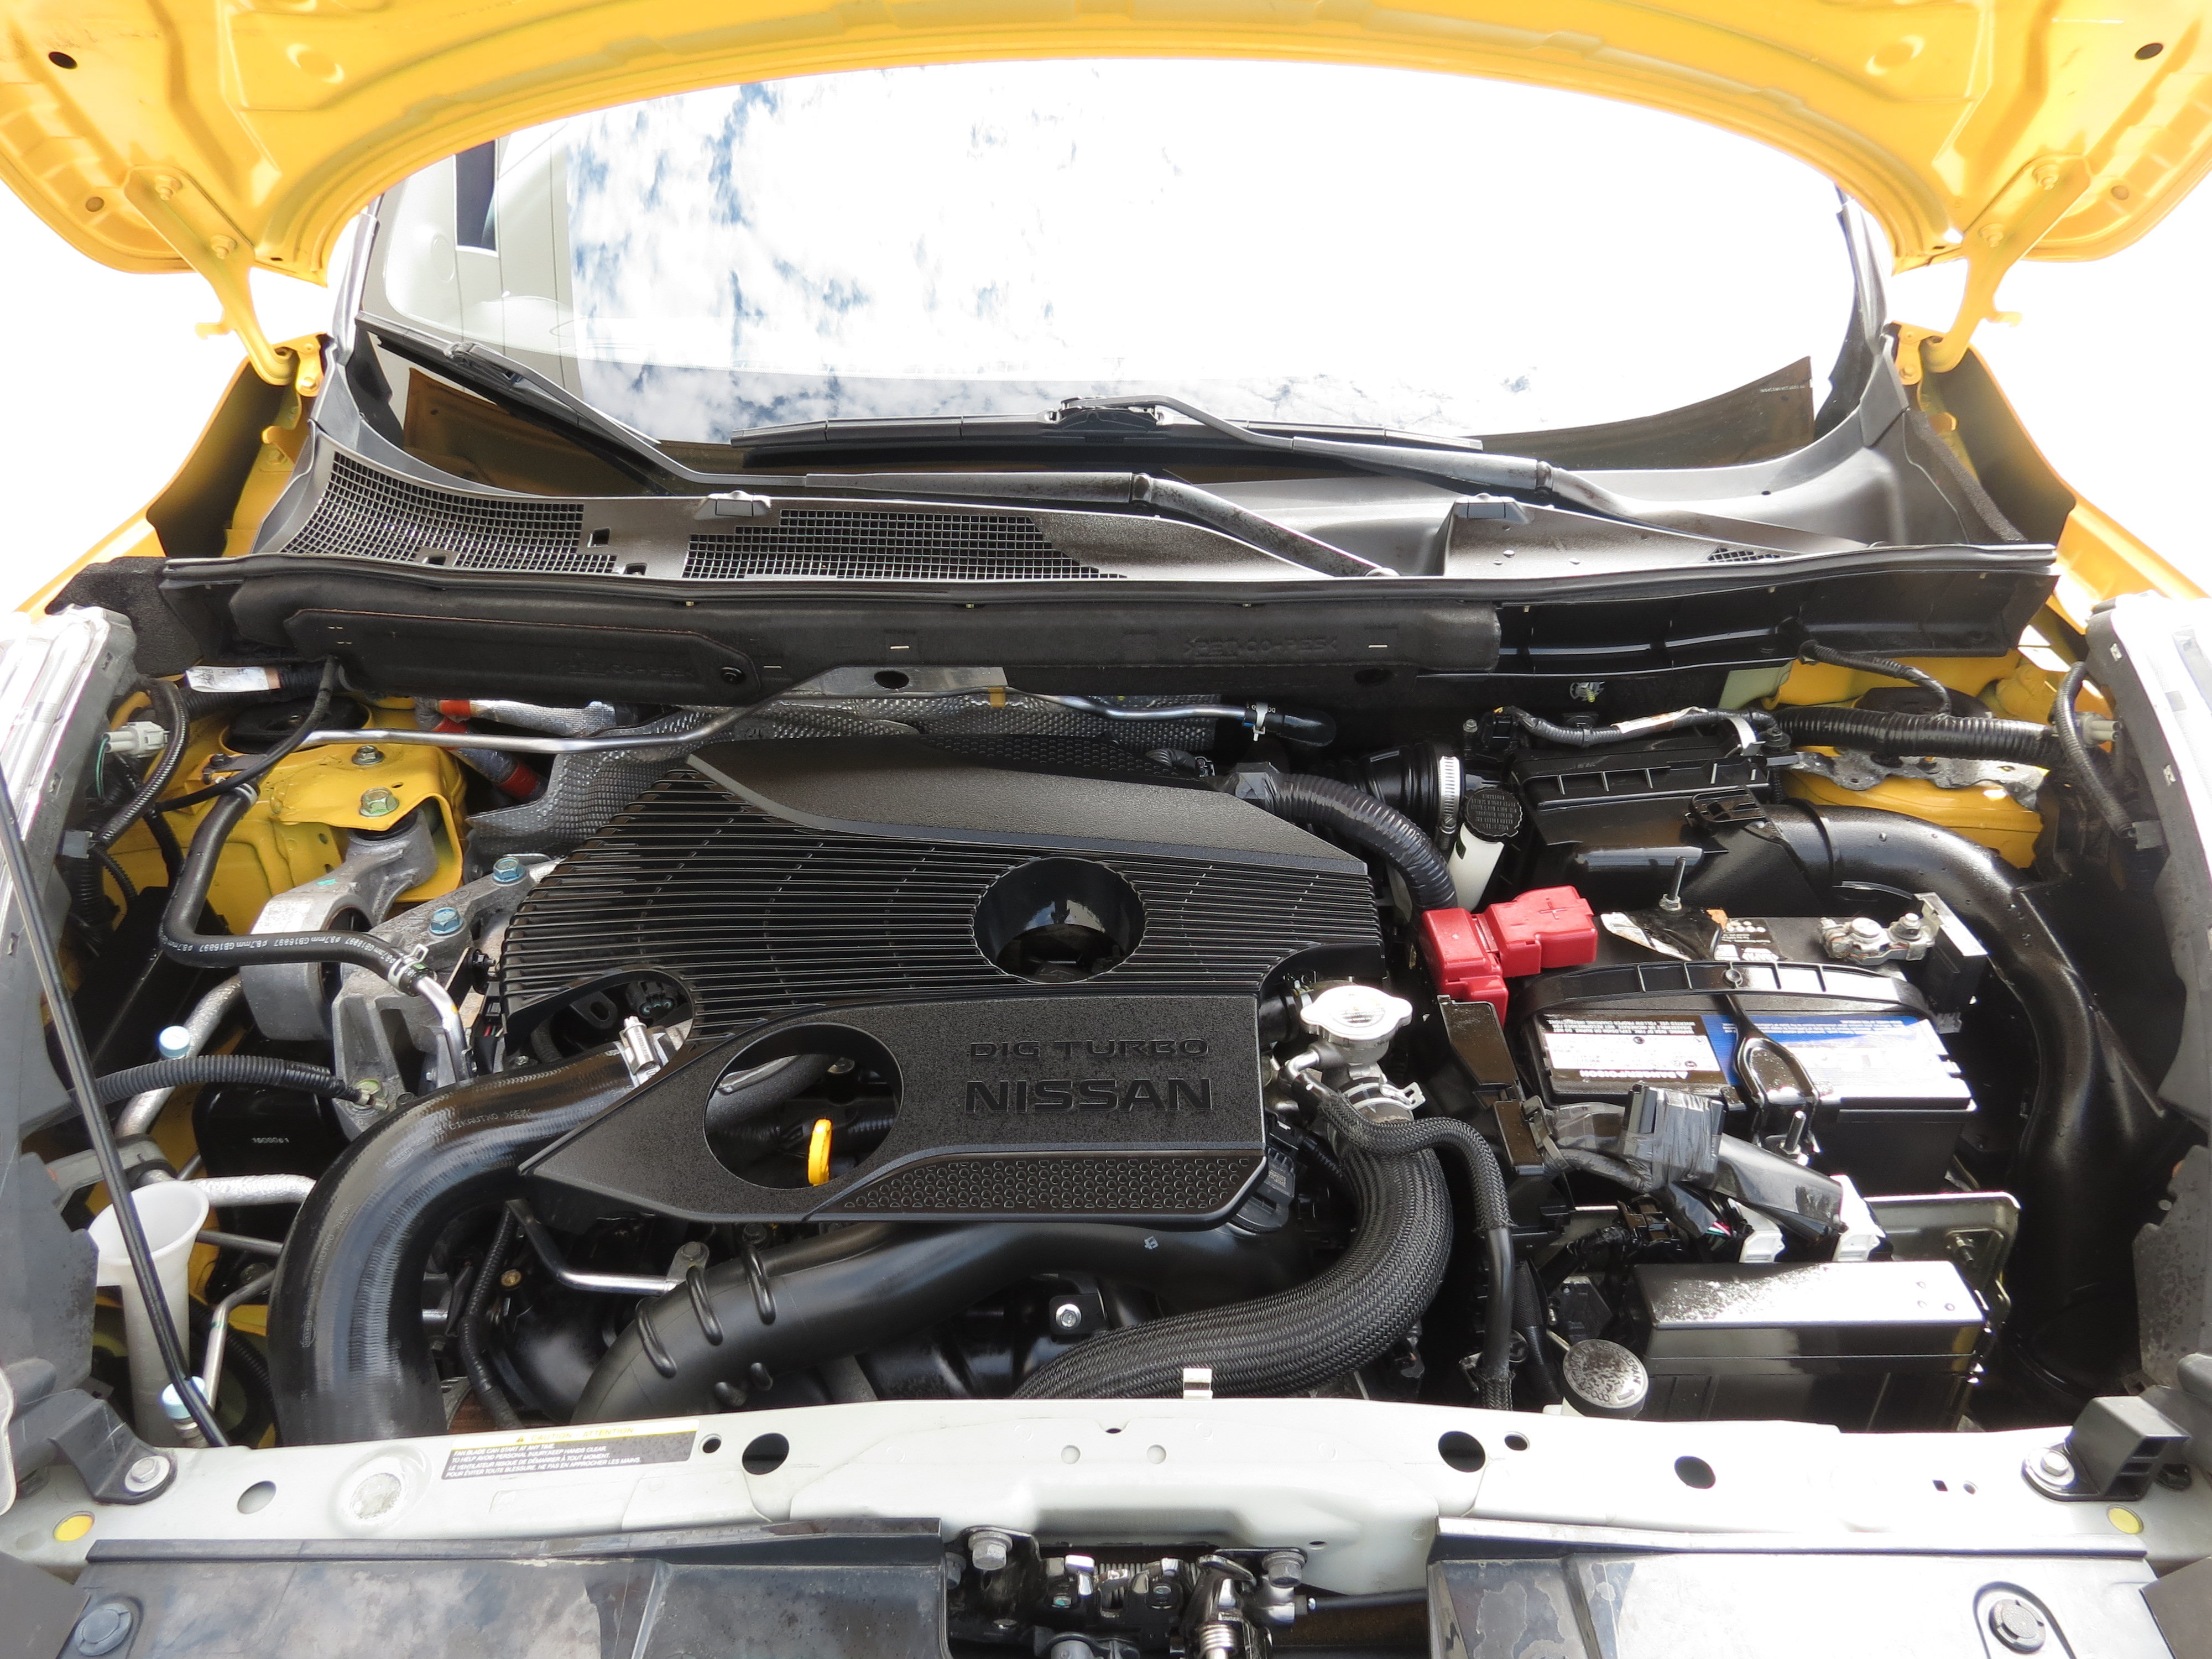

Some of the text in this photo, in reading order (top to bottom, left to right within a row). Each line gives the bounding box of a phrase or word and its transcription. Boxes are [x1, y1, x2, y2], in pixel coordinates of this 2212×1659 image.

[969, 1038, 1209, 1058] DIG TURBO
[964, 1078, 1213, 1114] NISSAN
[531, 1427, 634, 1442] CAUTION ATTENTION
[456, 1461, 495, 1470] VENTILATEUR
[527, 1455, 561, 1465] DÉMARRER
[495, 1452, 527, 1460] PERSONAL
[463, 1468, 484, 1477] ÉVITER
[568, 1458, 608, 1468] APPROCHER
